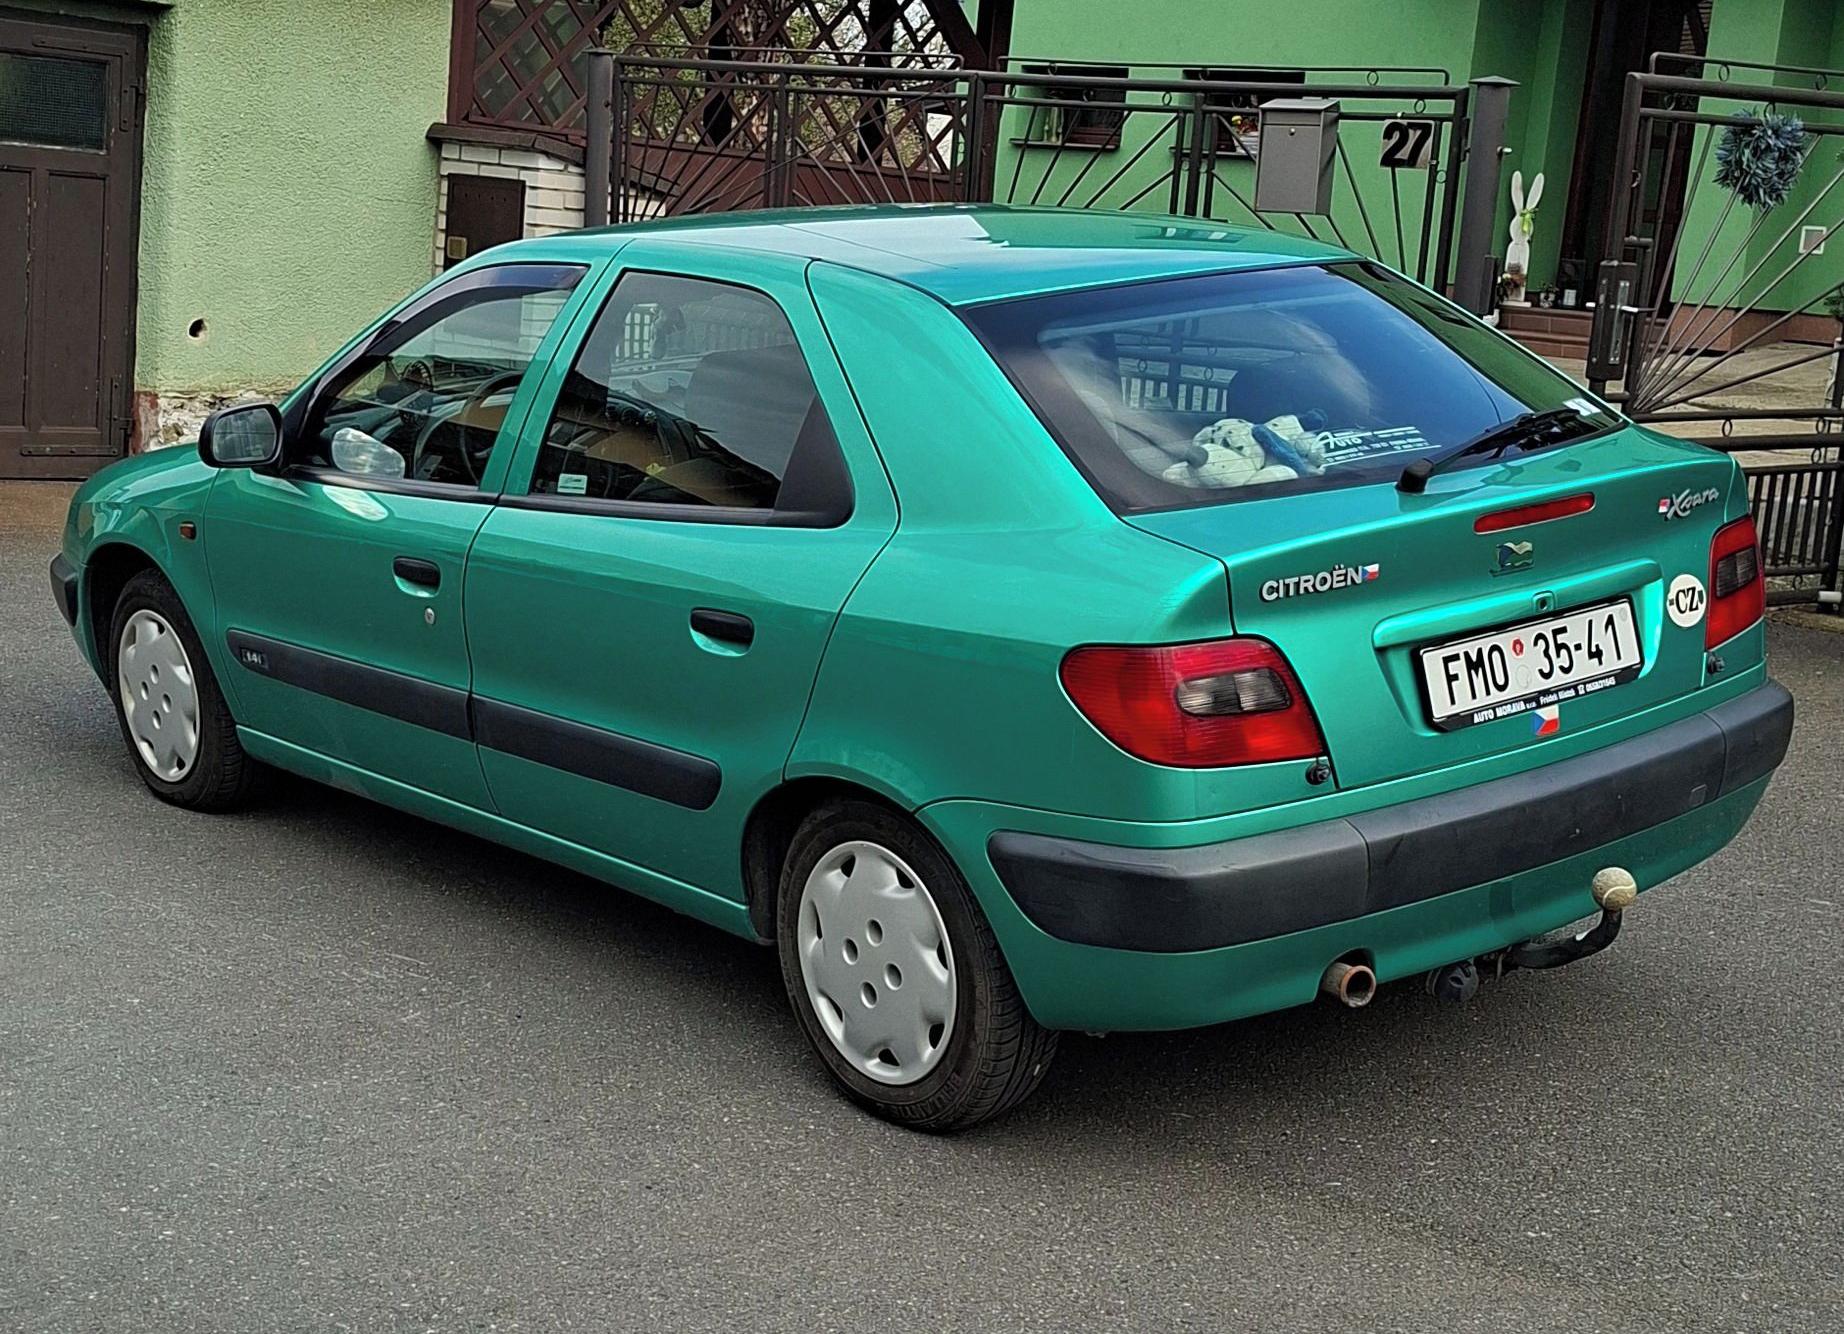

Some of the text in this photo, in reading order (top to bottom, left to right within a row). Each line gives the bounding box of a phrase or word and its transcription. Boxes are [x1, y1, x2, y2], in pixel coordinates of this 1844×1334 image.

[1380, 121, 1432, 167] 27
[1261, 563, 1363, 601] CITROËN
[1675, 586, 1699, 614] CZ
[1441, 613, 1622, 707] FMO 35-41
[1473, 709, 1495, 724] AUTO
[1495, 700, 1527, 717] MORAVA
